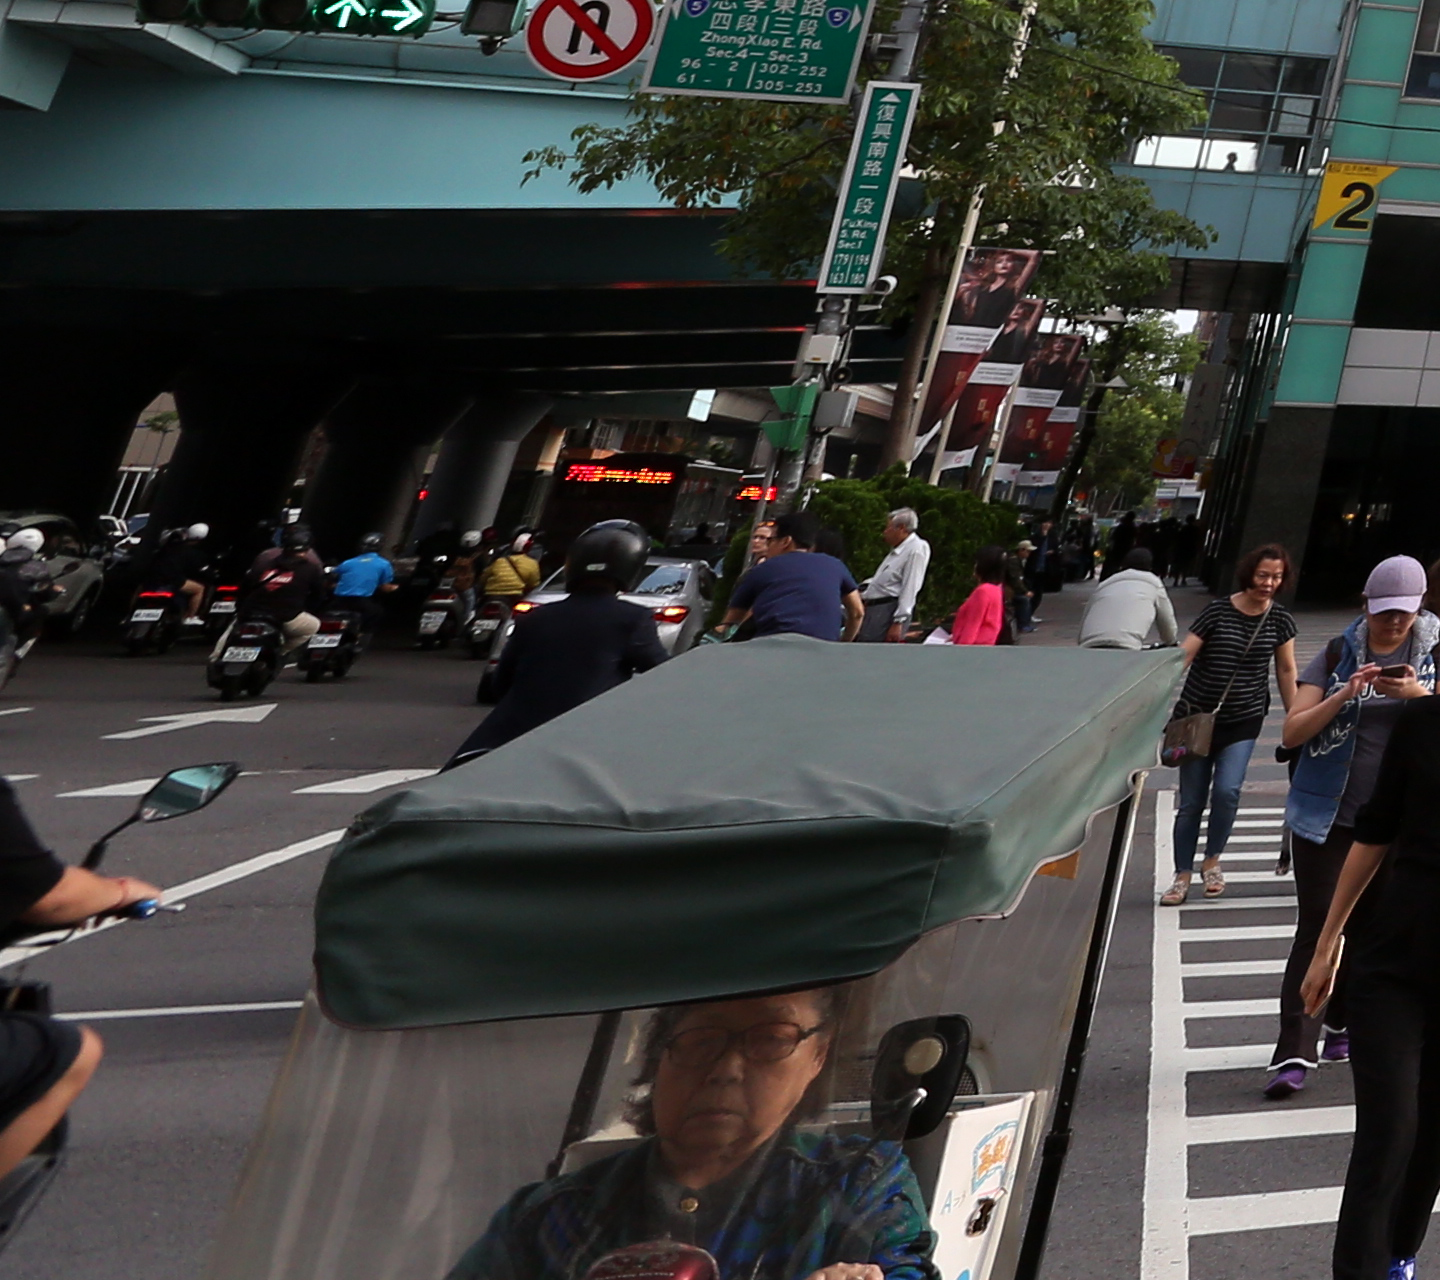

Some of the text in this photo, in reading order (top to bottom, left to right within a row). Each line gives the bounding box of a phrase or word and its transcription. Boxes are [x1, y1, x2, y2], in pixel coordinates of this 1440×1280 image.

[709, 12, 819, 37] 四段 三段
[800, 39, 823, 50] Rd.
[853, 103, 895, 215] 復興南路一段
[1332, 181, 1375, 229] 2
[841, 218, 879, 230] FuXing
